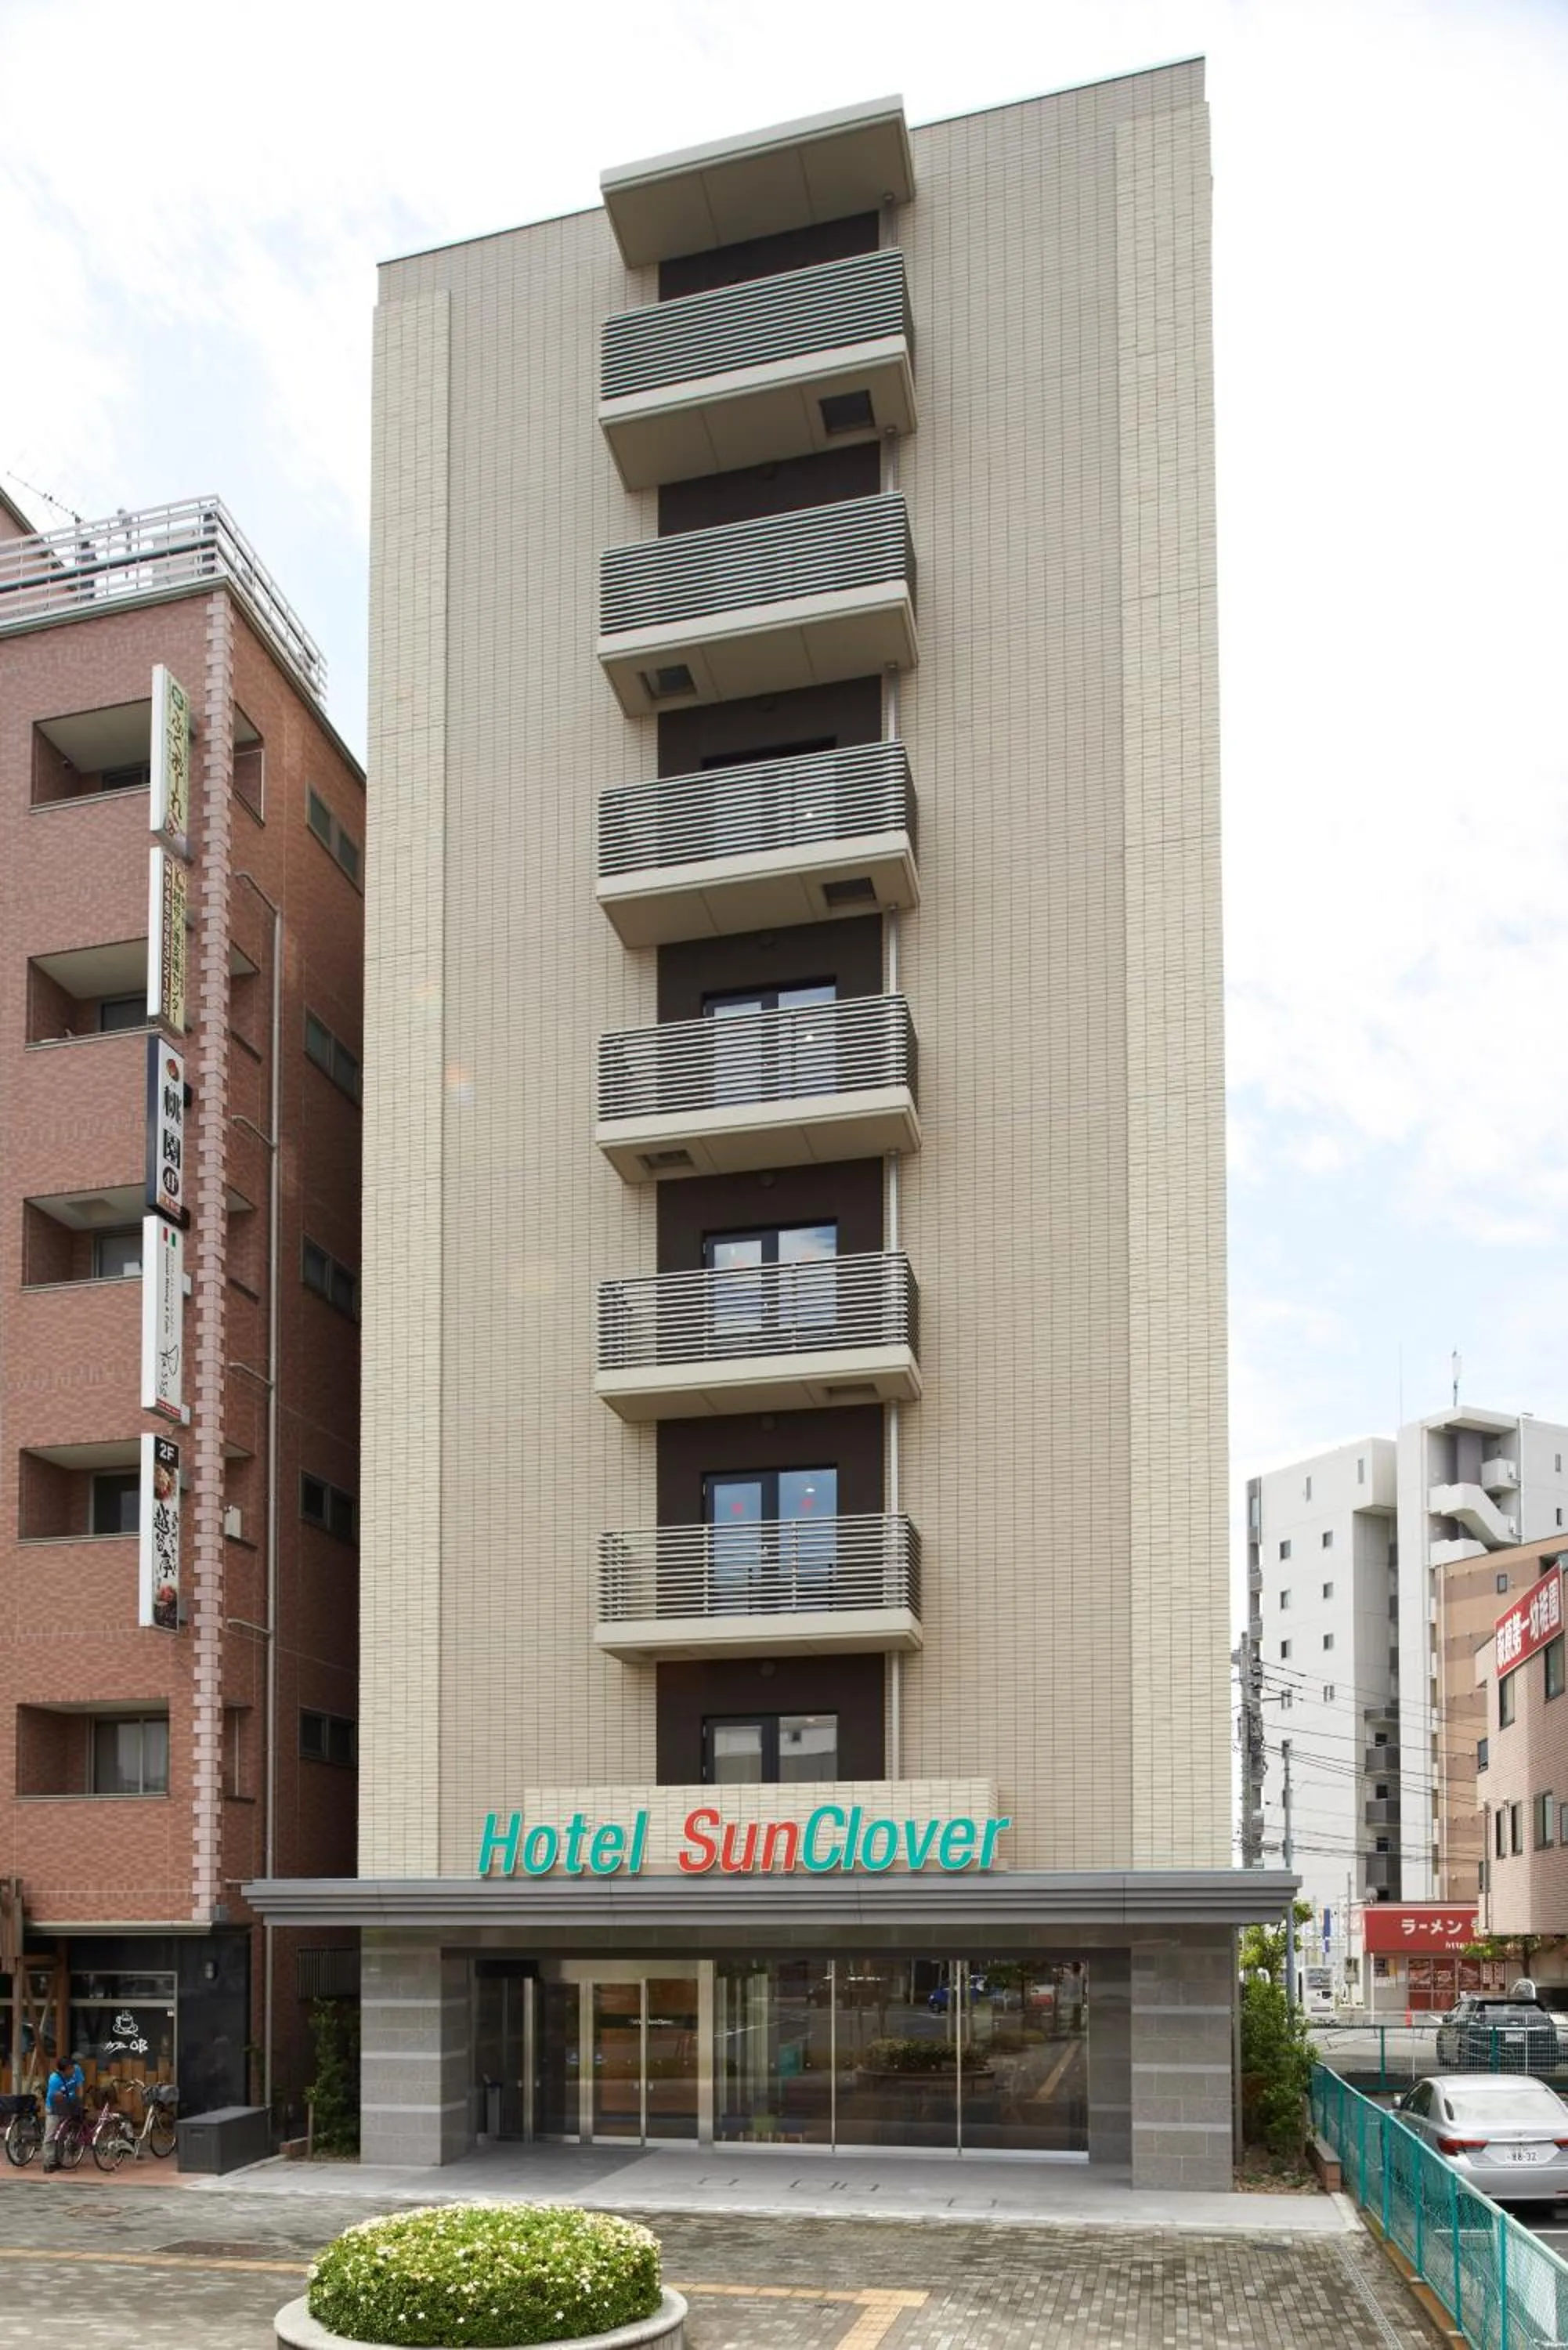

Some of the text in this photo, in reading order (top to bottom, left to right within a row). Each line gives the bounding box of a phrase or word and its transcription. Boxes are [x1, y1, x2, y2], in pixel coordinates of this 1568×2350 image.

[159, 1442, 175, 1460] 2F
[478, 1805, 1011, 1875] Hotel SunClover
[1400, 1918, 1463, 1935] ラーメン
[129, 2038, 148, 2053] OB
